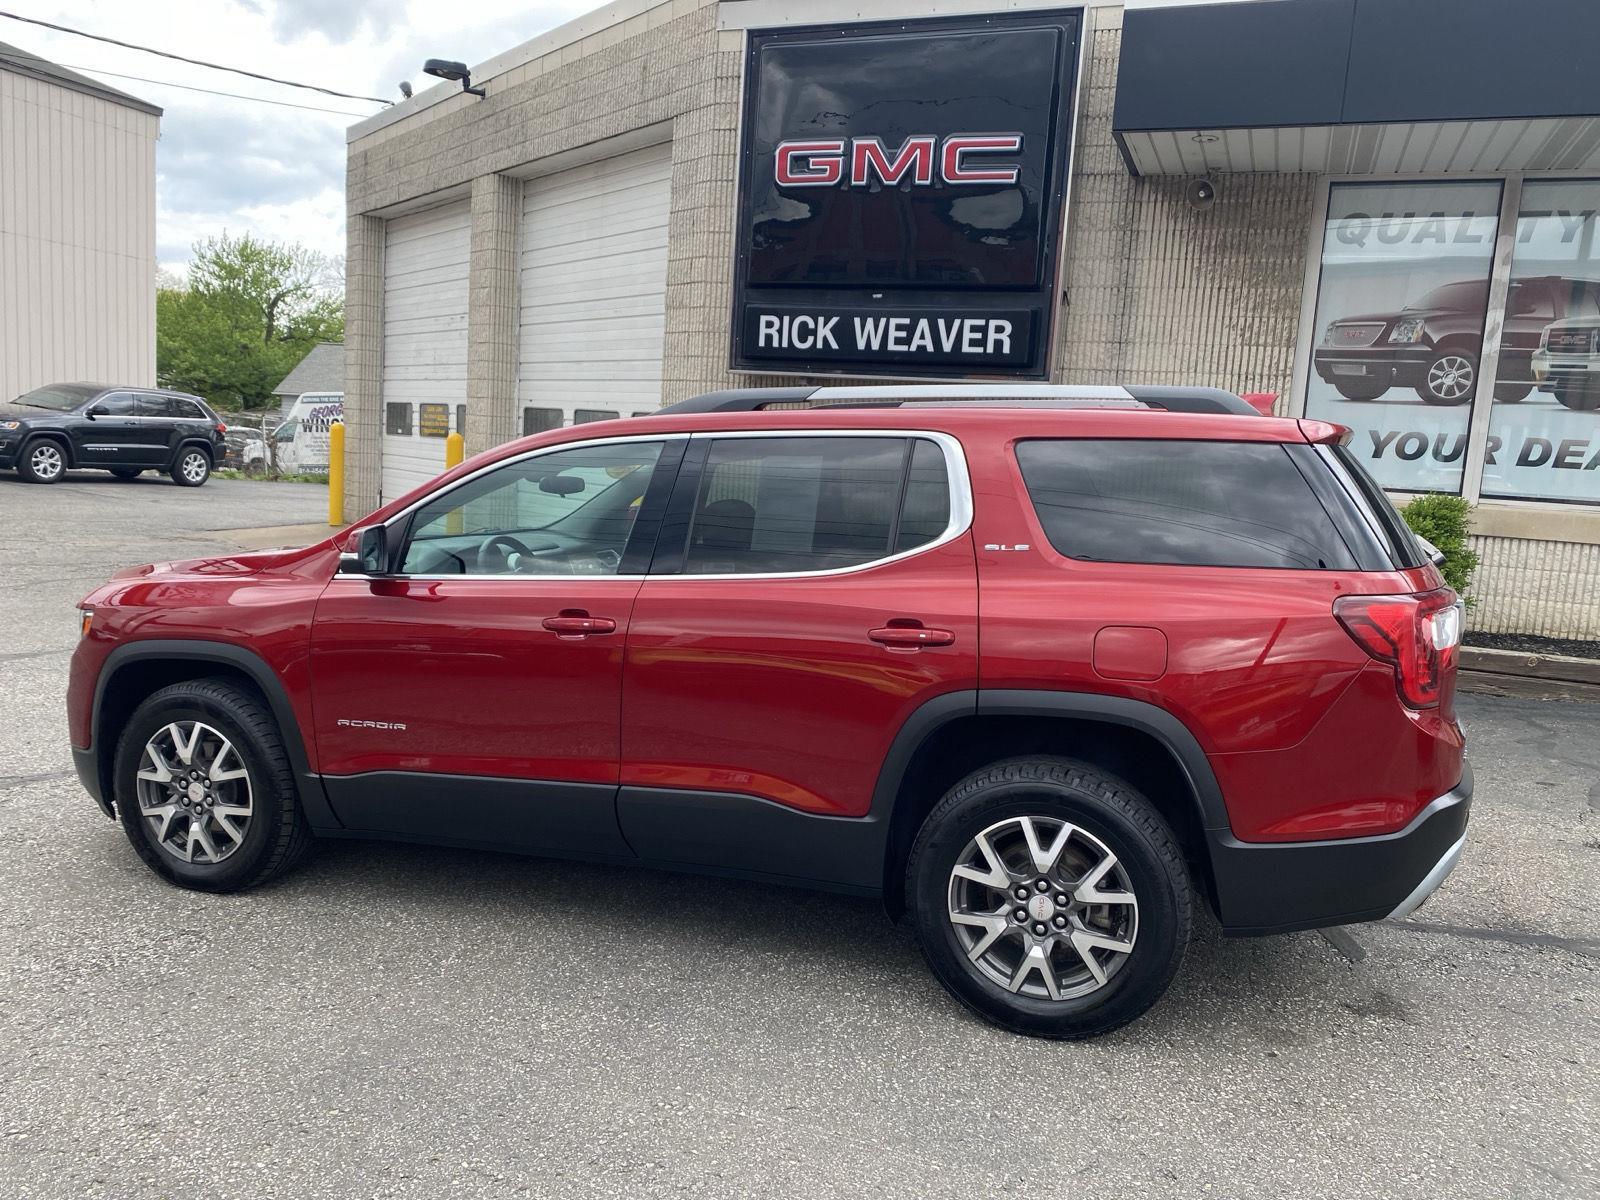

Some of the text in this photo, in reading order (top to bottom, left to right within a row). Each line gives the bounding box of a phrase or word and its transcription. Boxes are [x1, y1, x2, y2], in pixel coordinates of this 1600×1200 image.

[774, 133, 1023, 187] GMC
[1336, 209, 1597, 247] QUALTY
[758, 314, 1013, 355] RICK WEAVER
[310, 401, 344, 420] GEORG
[984, 543, 1030, 551] SLE
[337, 719, 406, 730] ACADIA
